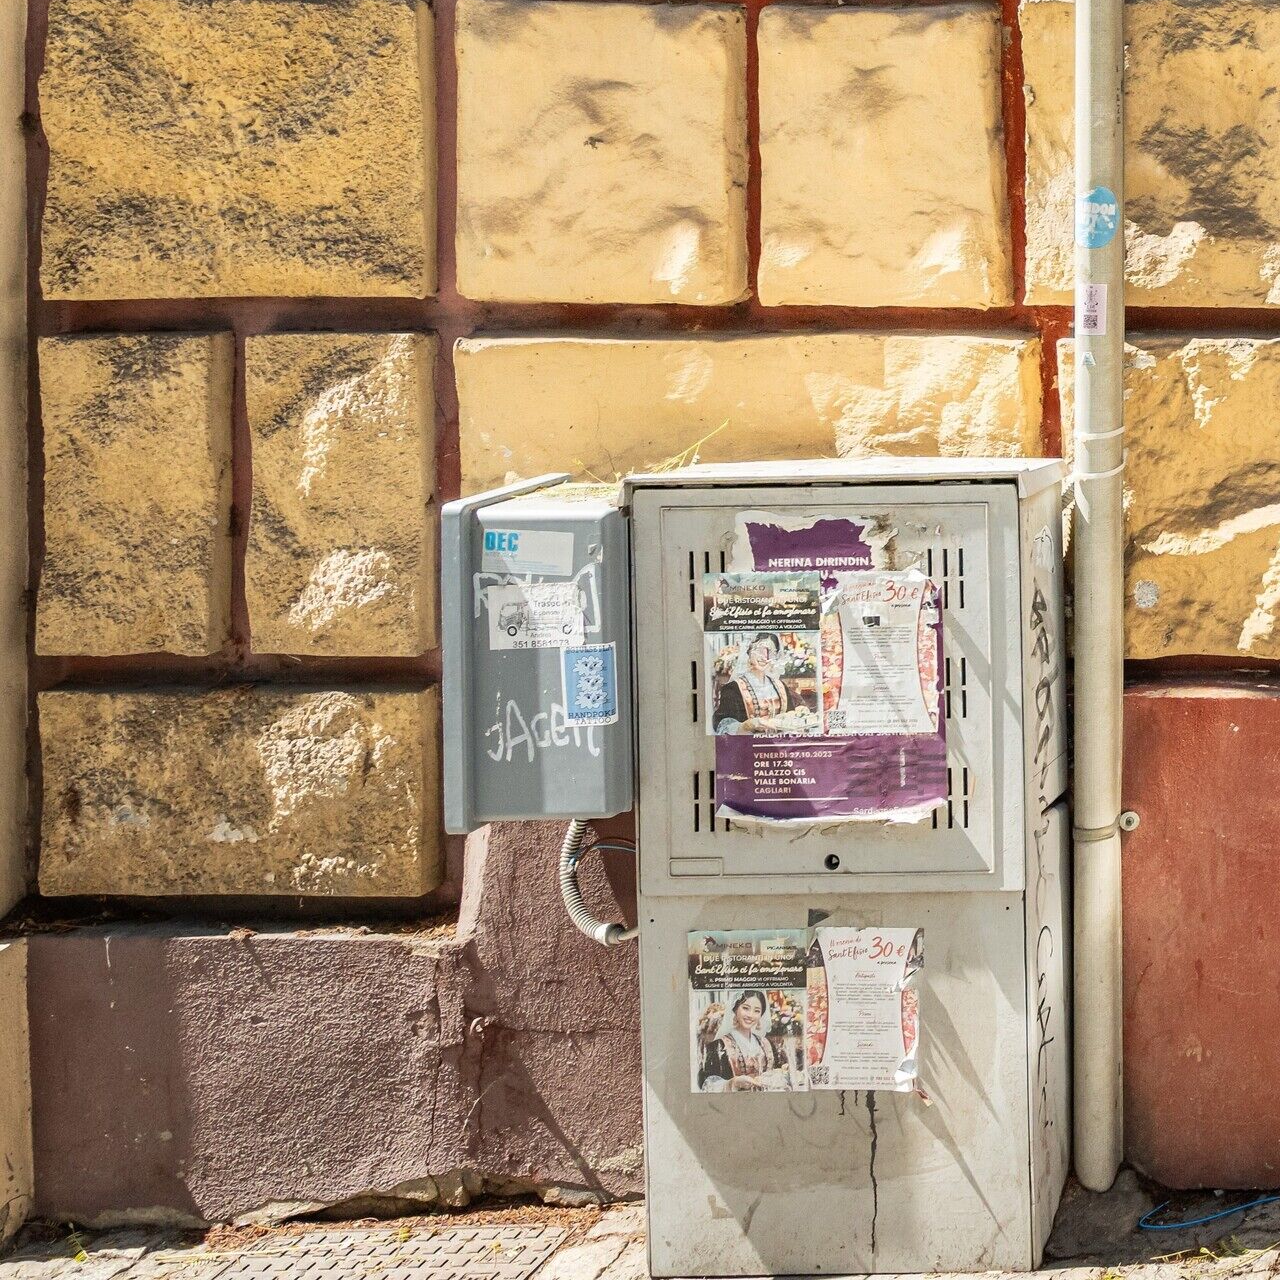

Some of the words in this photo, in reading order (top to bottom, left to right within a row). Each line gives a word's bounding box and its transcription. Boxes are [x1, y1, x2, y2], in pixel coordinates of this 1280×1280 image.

[768, 557, 813, 569] NERINA
[815, 556, 869, 568] DIRINDIN
[882, 580, 907, 602] 30
[911, 587, 919, 600] €
[512, 640, 528, 649] 351
[567, 708, 617, 720] HANDPOKE
[575, 716, 612, 725] TATTOO
[753, 750, 788, 759] VENERDÌ
[789, 750, 833, 759] 27.10.2023
[772, 760, 794, 768] 17.30
[753, 769, 792, 777] PALAZZO
[793, 768, 806, 776] CIS
[754, 778, 777, 786] VIALE
[778, 777, 817, 785] BONARIA
[868, 936, 894, 960] 30
[896, 944, 906, 957] €
